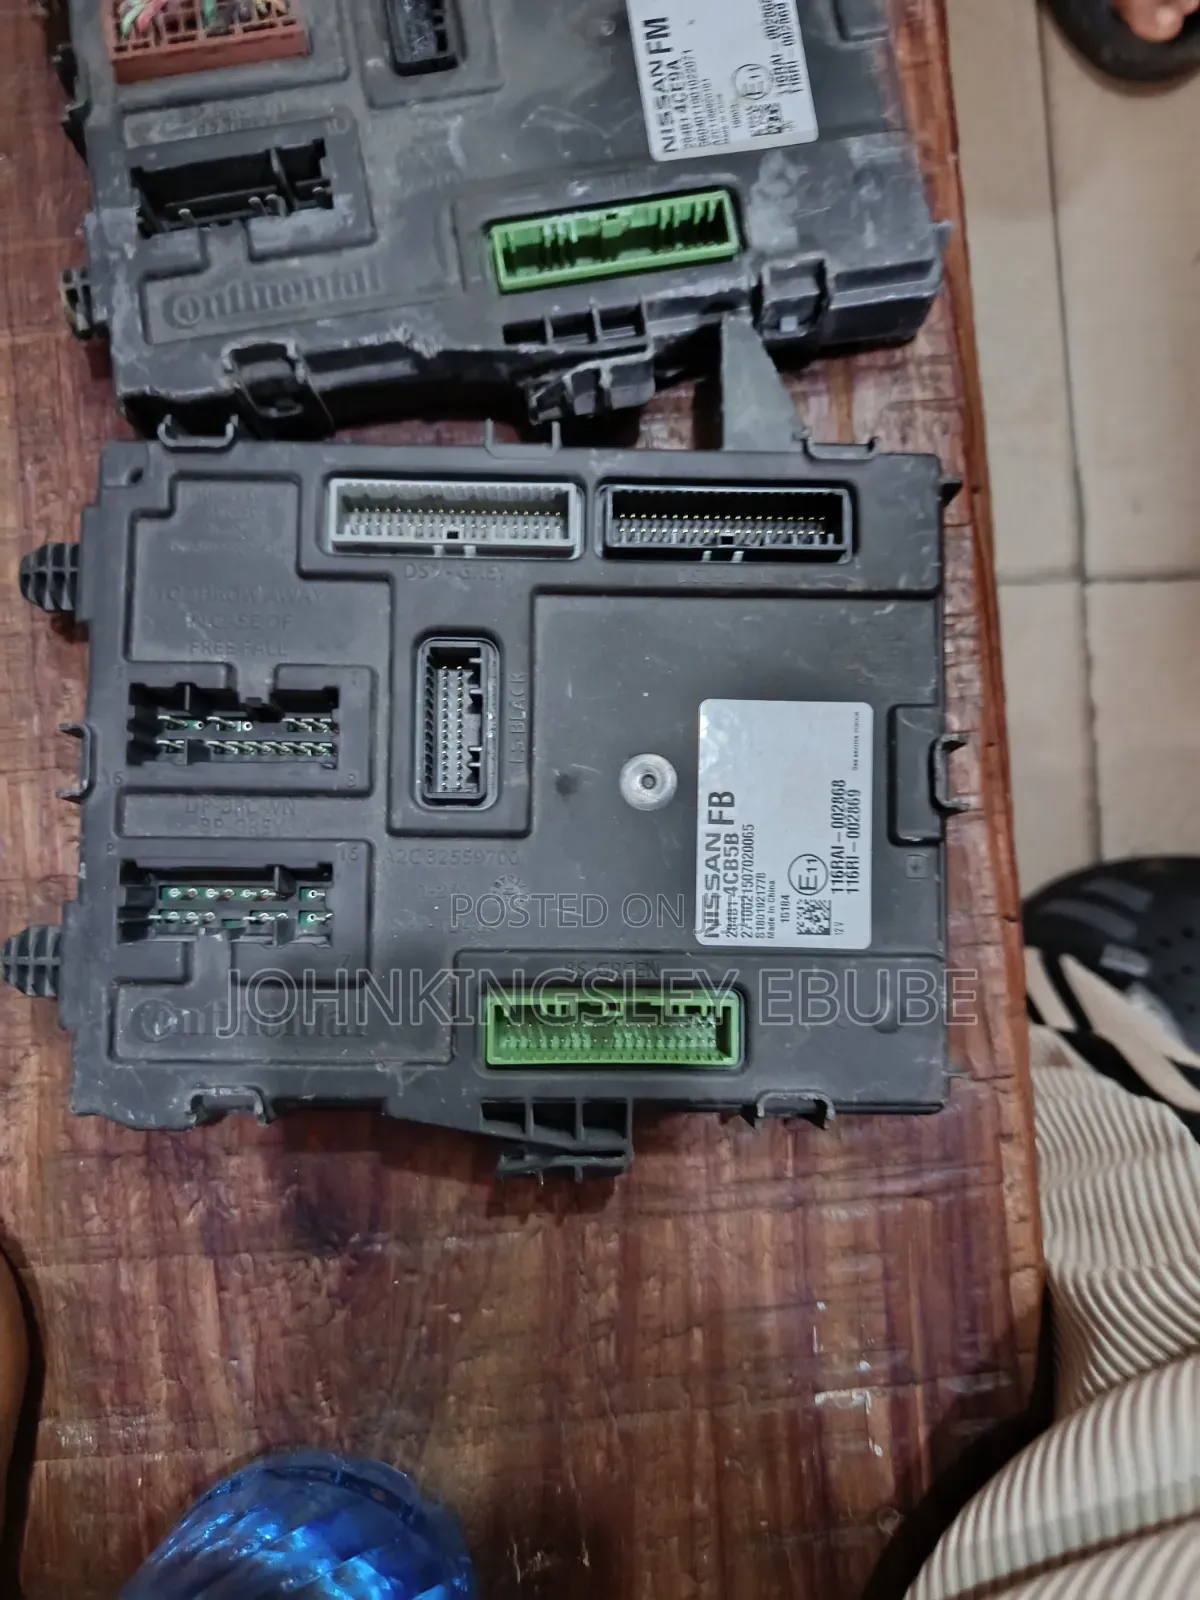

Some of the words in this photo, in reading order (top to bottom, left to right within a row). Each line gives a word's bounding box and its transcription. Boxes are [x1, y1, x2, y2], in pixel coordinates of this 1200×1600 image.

[642, 17, 673, 54] FM
[648, 59, 678, 153] NISSAN
[708, 791, 735, 825] FB
[704, 832, 721, 939] NISSAN
[767, 881, 776, 903] China
[767, 916, 777, 939] Made
